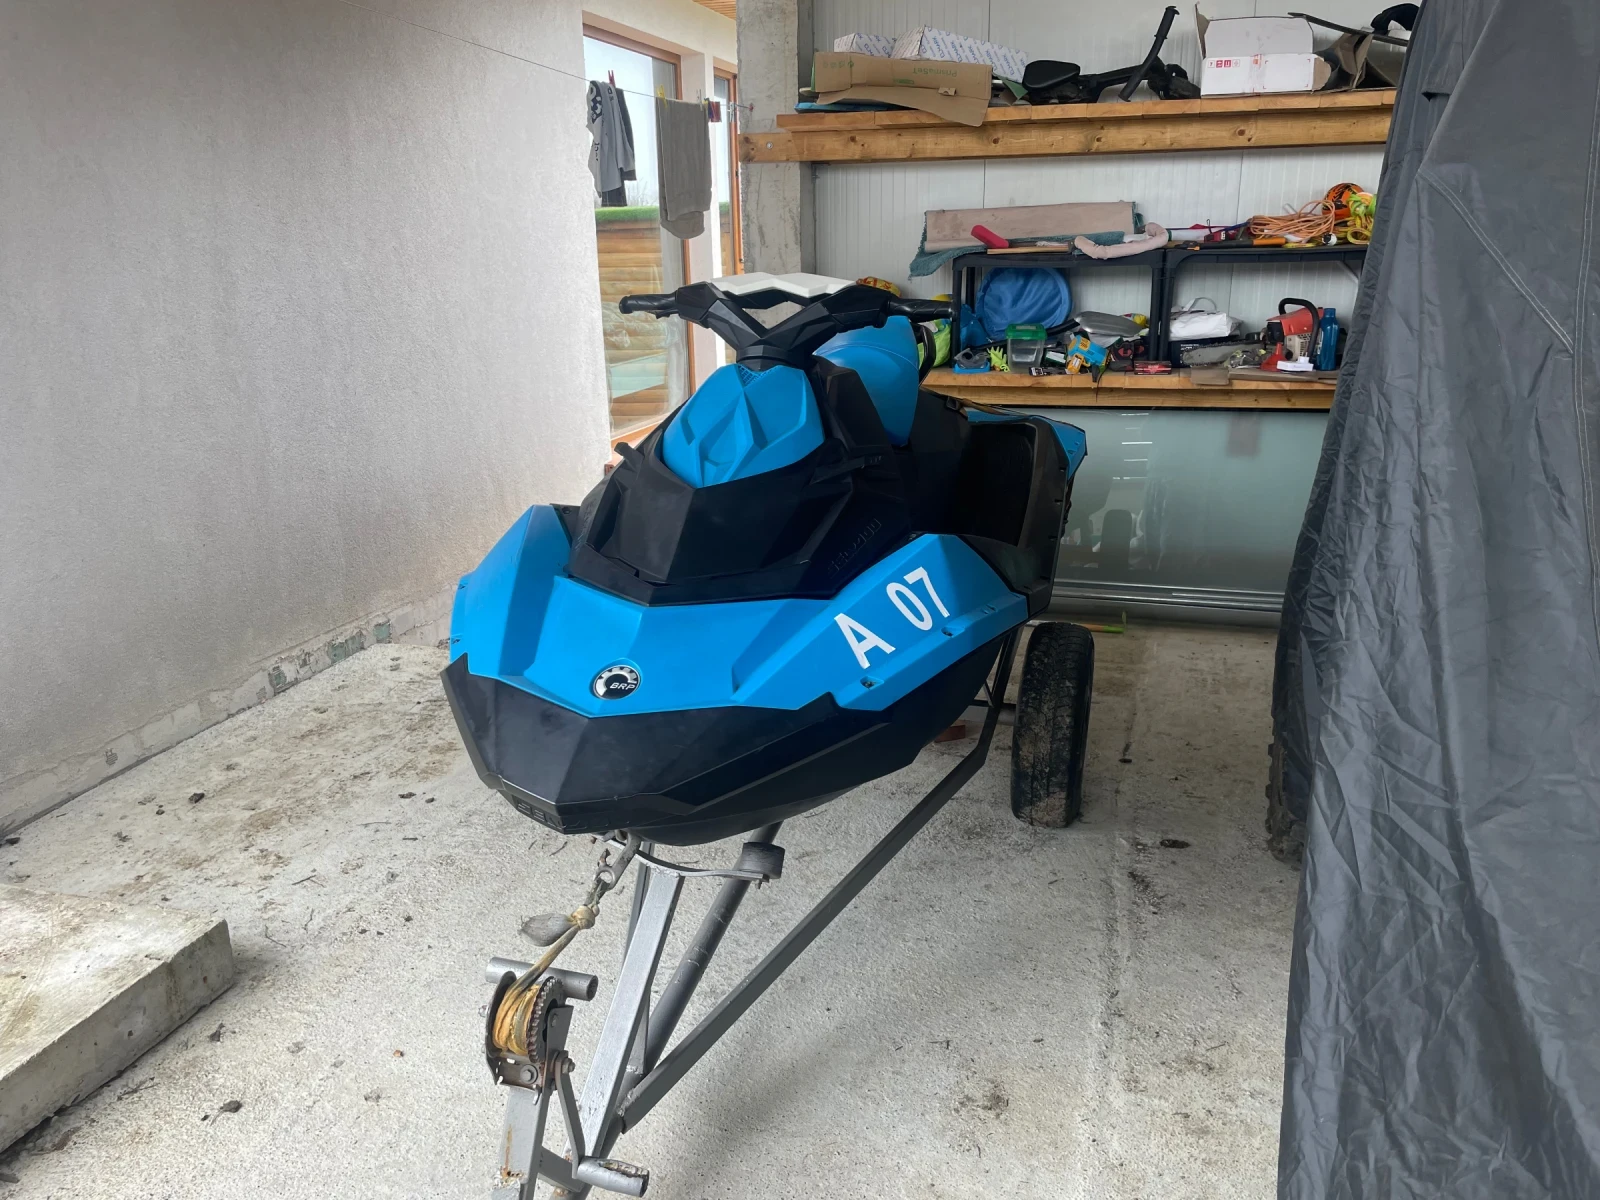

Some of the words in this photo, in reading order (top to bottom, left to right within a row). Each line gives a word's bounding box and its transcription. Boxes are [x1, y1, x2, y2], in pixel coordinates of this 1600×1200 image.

[912, 66, 958, 77] PrismaSeT
[834, 612, 896, 669] A
[886, 566, 950, 631] 07
[609, 682, 636, 691] BRP
